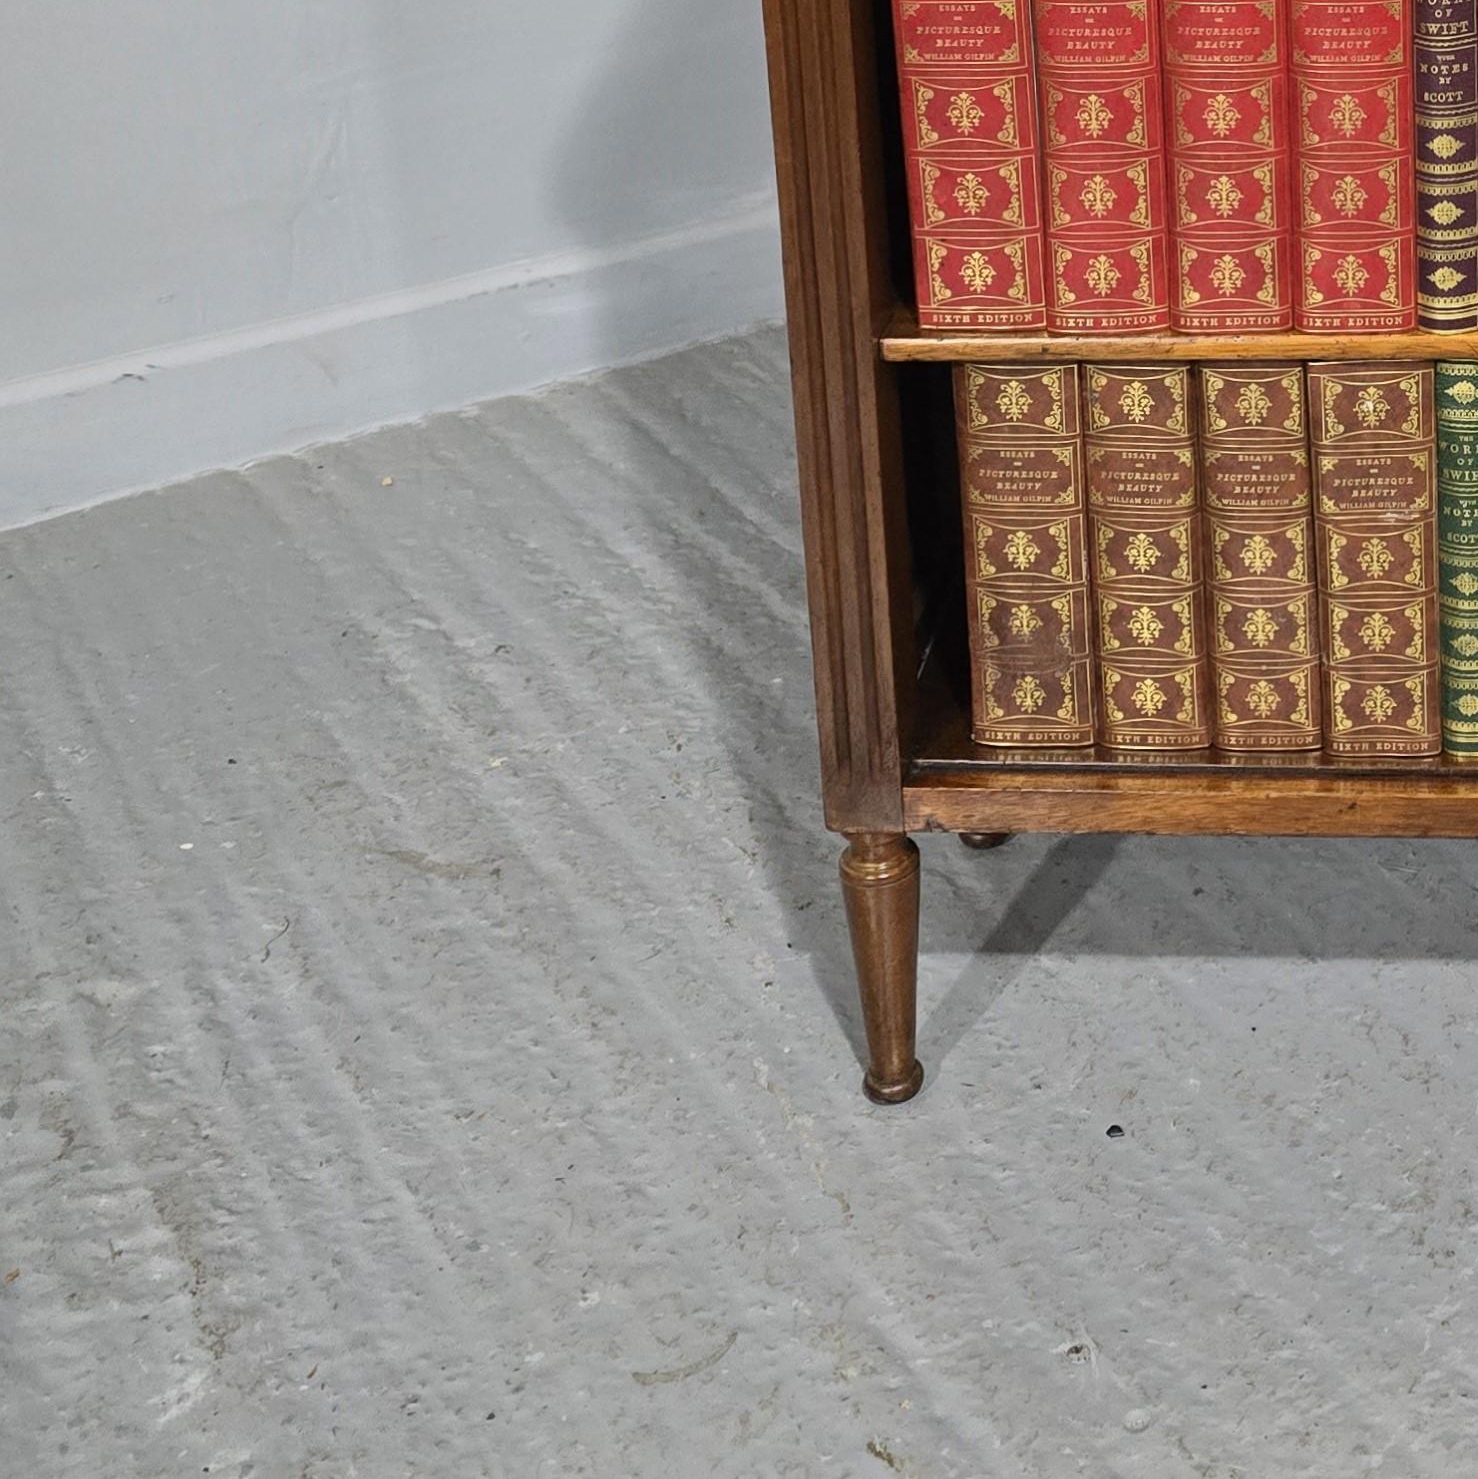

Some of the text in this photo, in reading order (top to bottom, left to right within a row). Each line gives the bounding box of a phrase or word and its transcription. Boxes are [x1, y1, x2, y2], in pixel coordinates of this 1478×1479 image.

[1434, 9, 1452, 18] OF
[916, 26, 1001, 35] PICTURESQUE
[1048, 27, 1132, 36] PICTURESQUE
[1177, 26, 1261, 36] PICTURESQUE
[1304, 26, 1388, 36] PICTURESQUE
[1420, 21, 1469, 34] SWIFT
[935, 39, 984, 47] BEAUTY
[1066, 41, 1115, 49] BEAUTY
[1195, 40, 1244, 49] BEAUTY
[1322, 40, 1372, 49] BEAUTY
[1420, 63, 1469, 74] NOTES
[1424, 91, 1464, 102] SCOTT
[933, 313, 1033, 323] SIXTH EDITION
[1056, 315, 1157, 327] SIXTH EDITION
[1180, 316, 1281, 326] SIXTH EDITION
[1303, 316, 1404, 327] SIXTH EDITION
[978, 469, 1058, 479] PICTURESQUE
[1216, 473, 1296, 482] PICTURESQUE
[1333, 477, 1414, 487] PICTURESQUE
[1233, 486, 1280, 494] BEAUTY
[1351, 489, 1397, 498] BEAUTY
[1376, 742, 1429, 751] EDITION
